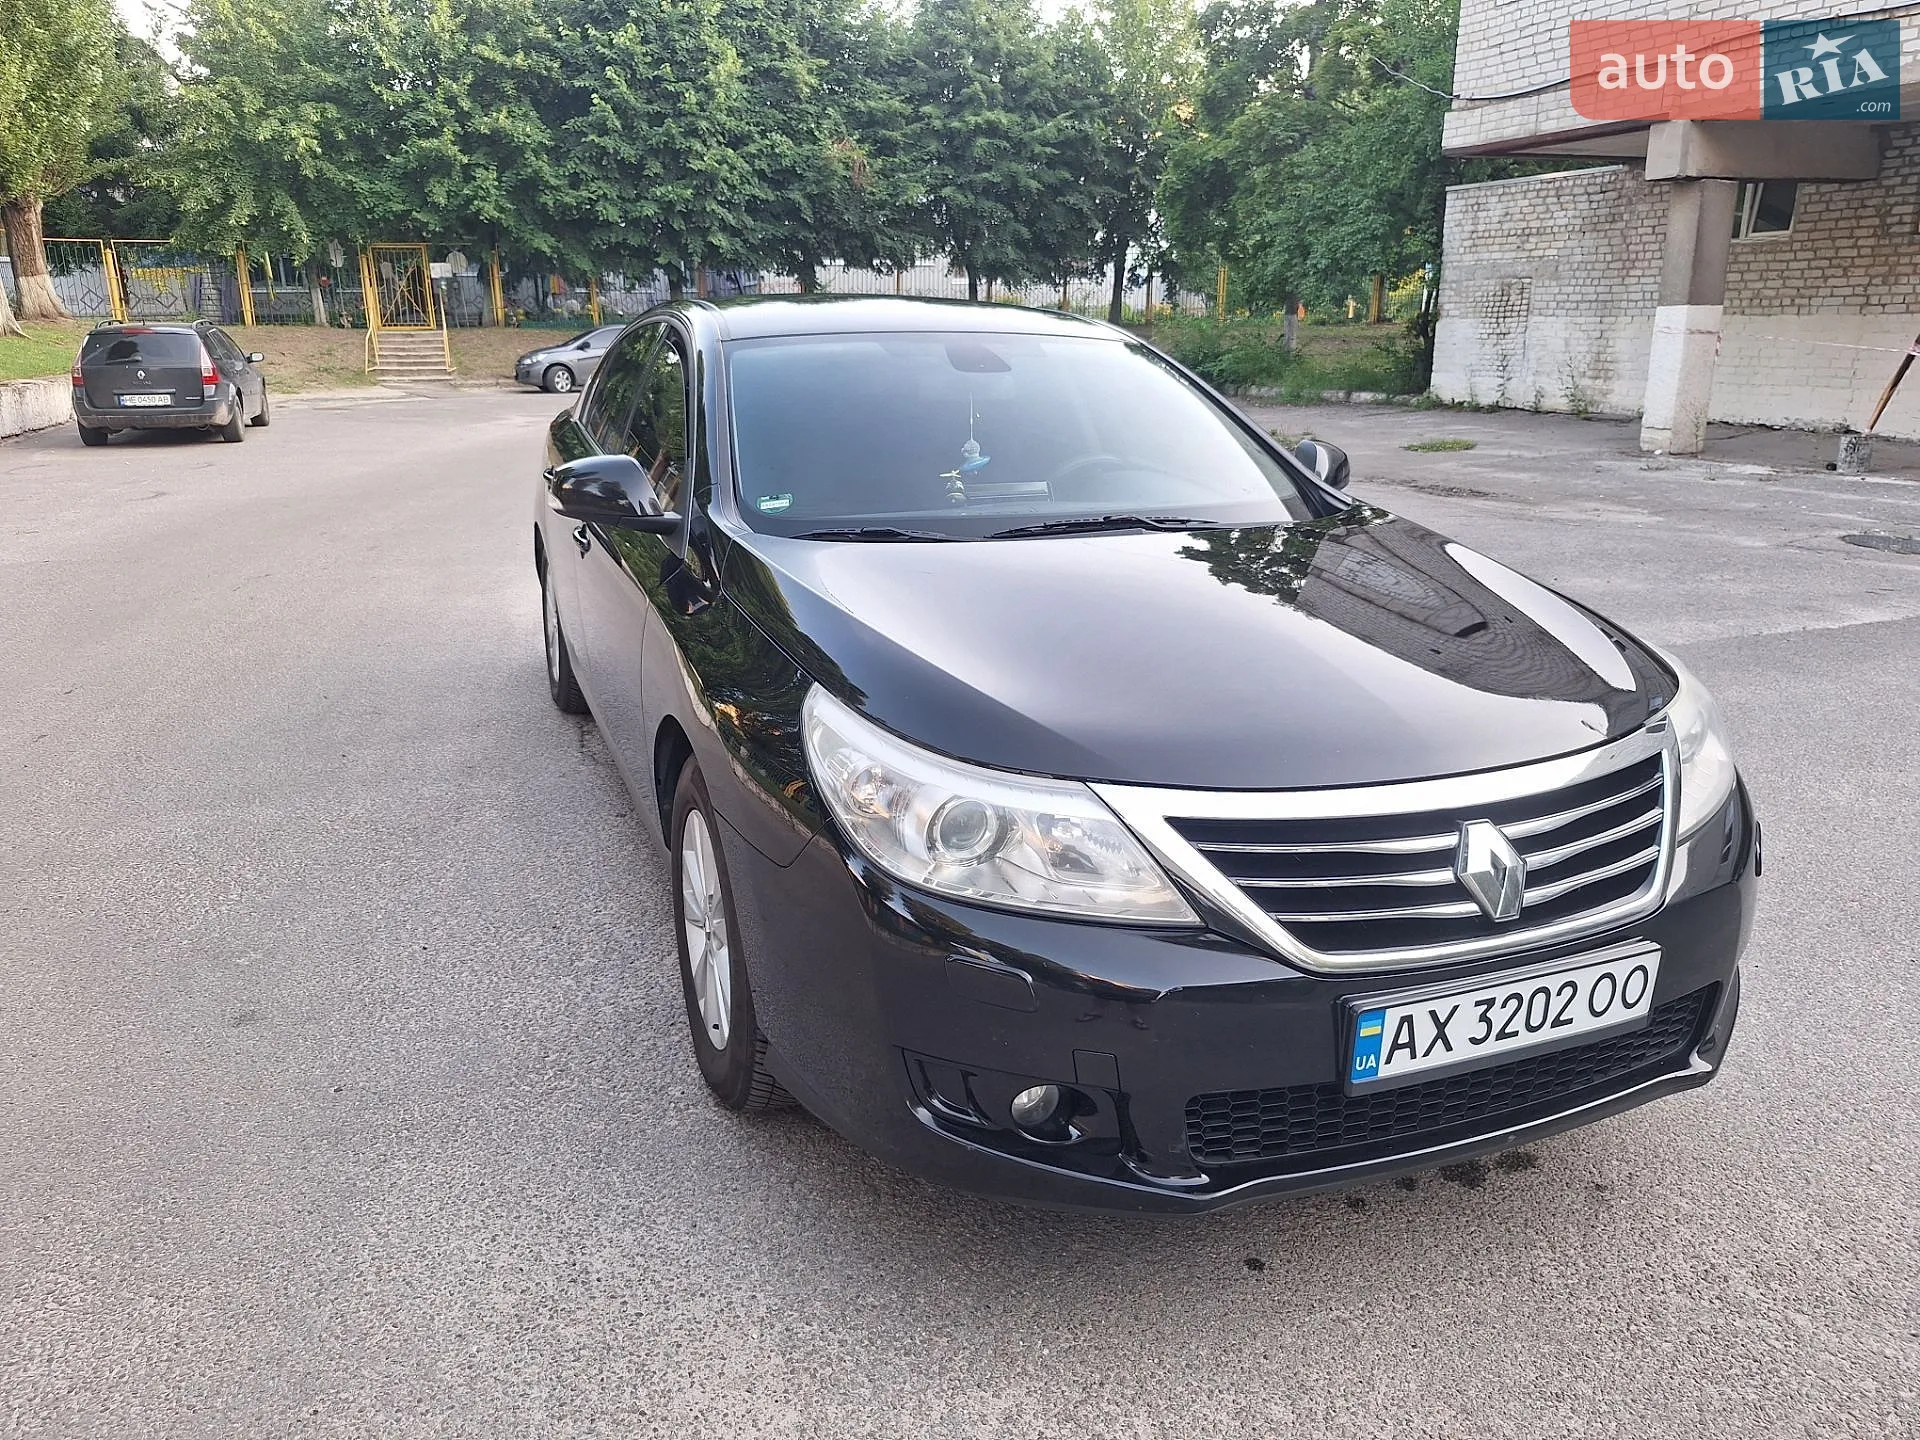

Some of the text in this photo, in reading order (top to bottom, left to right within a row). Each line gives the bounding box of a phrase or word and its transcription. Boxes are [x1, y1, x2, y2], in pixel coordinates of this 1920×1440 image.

[1383, 963, 1650, 1066] AX 3202 OO
[1355, 1055, 1377, 1072] UA
